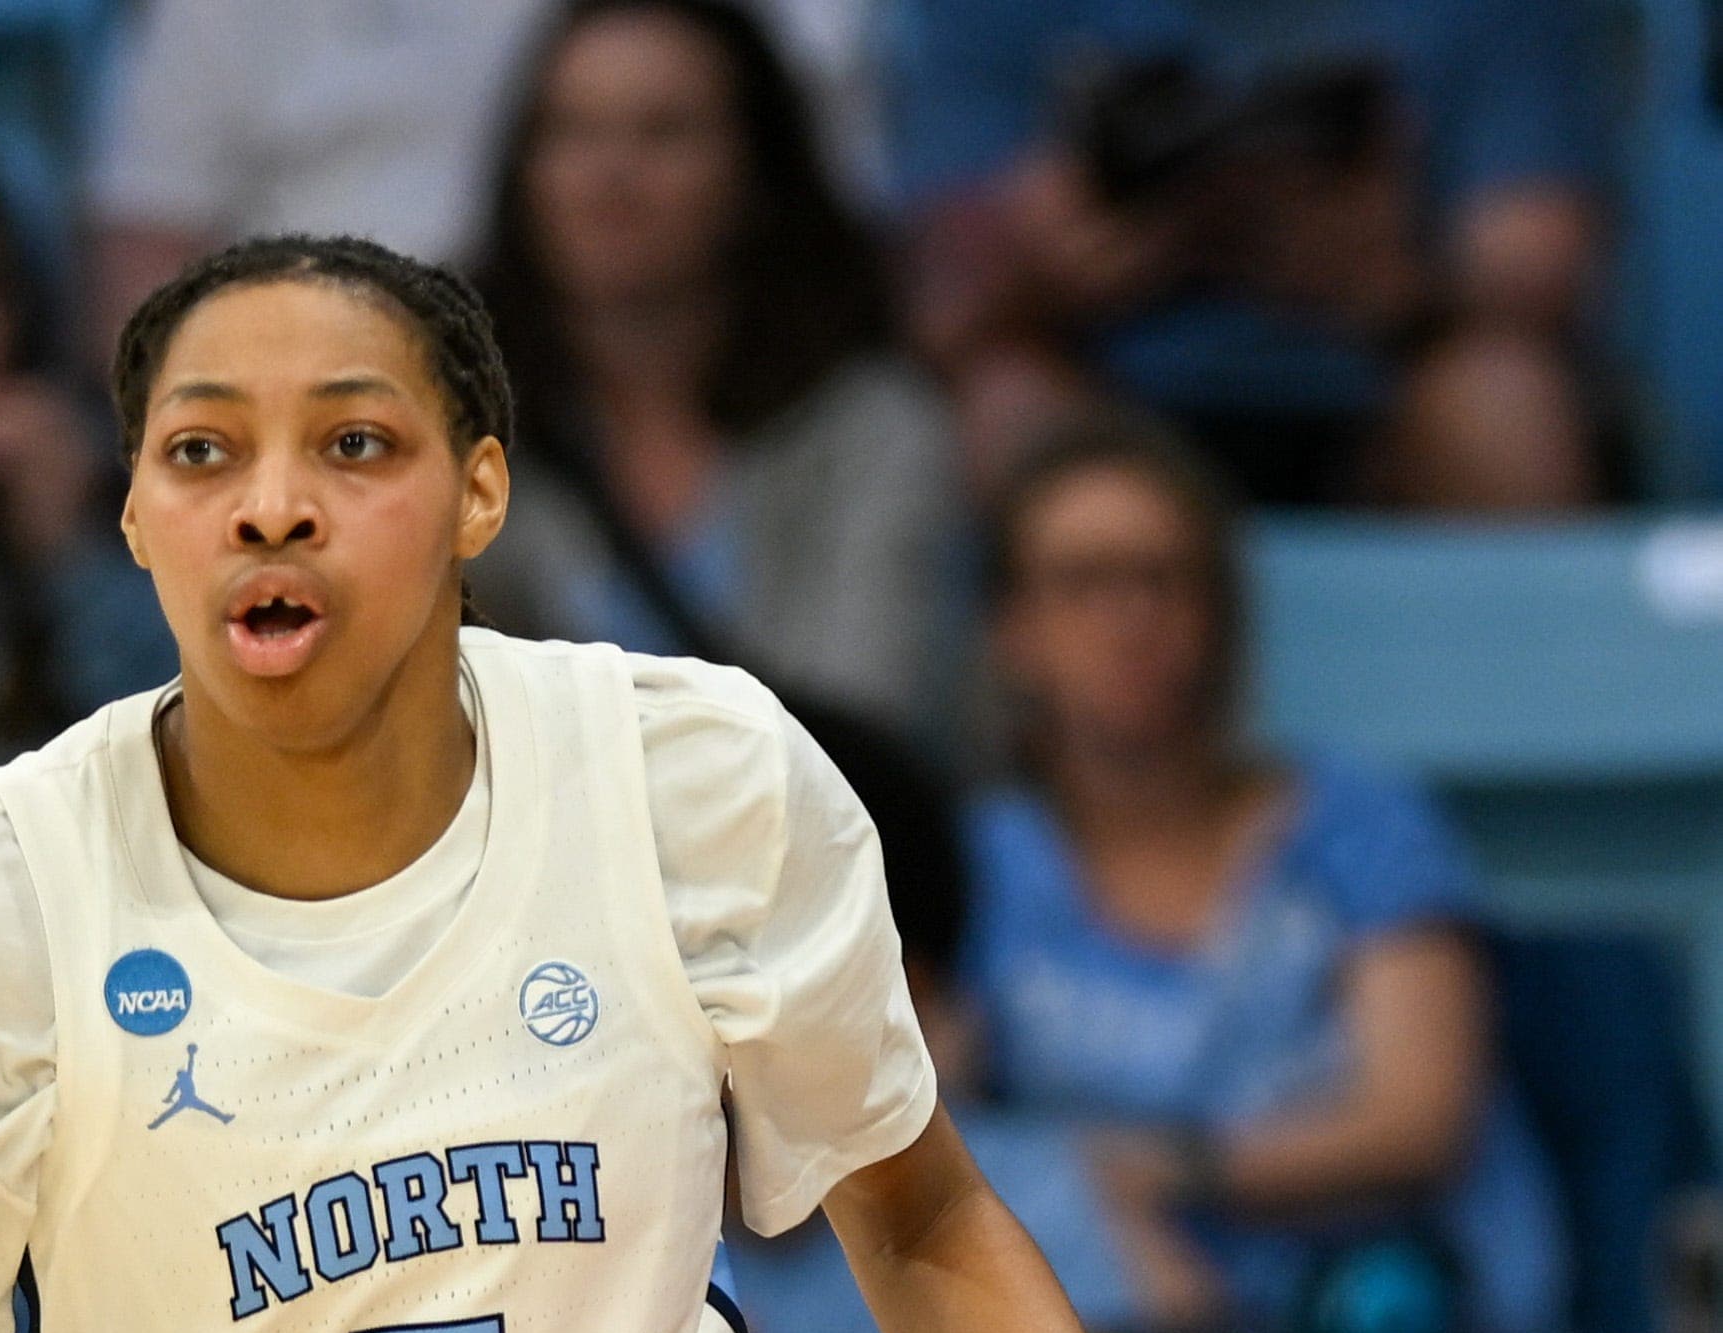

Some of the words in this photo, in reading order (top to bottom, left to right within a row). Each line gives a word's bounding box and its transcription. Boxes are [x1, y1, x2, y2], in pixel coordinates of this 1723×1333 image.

[118, 988, 186, 1015] NCAA
[531, 985, 589, 1012] ACC
[216, 1140, 606, 1321] NORTH
